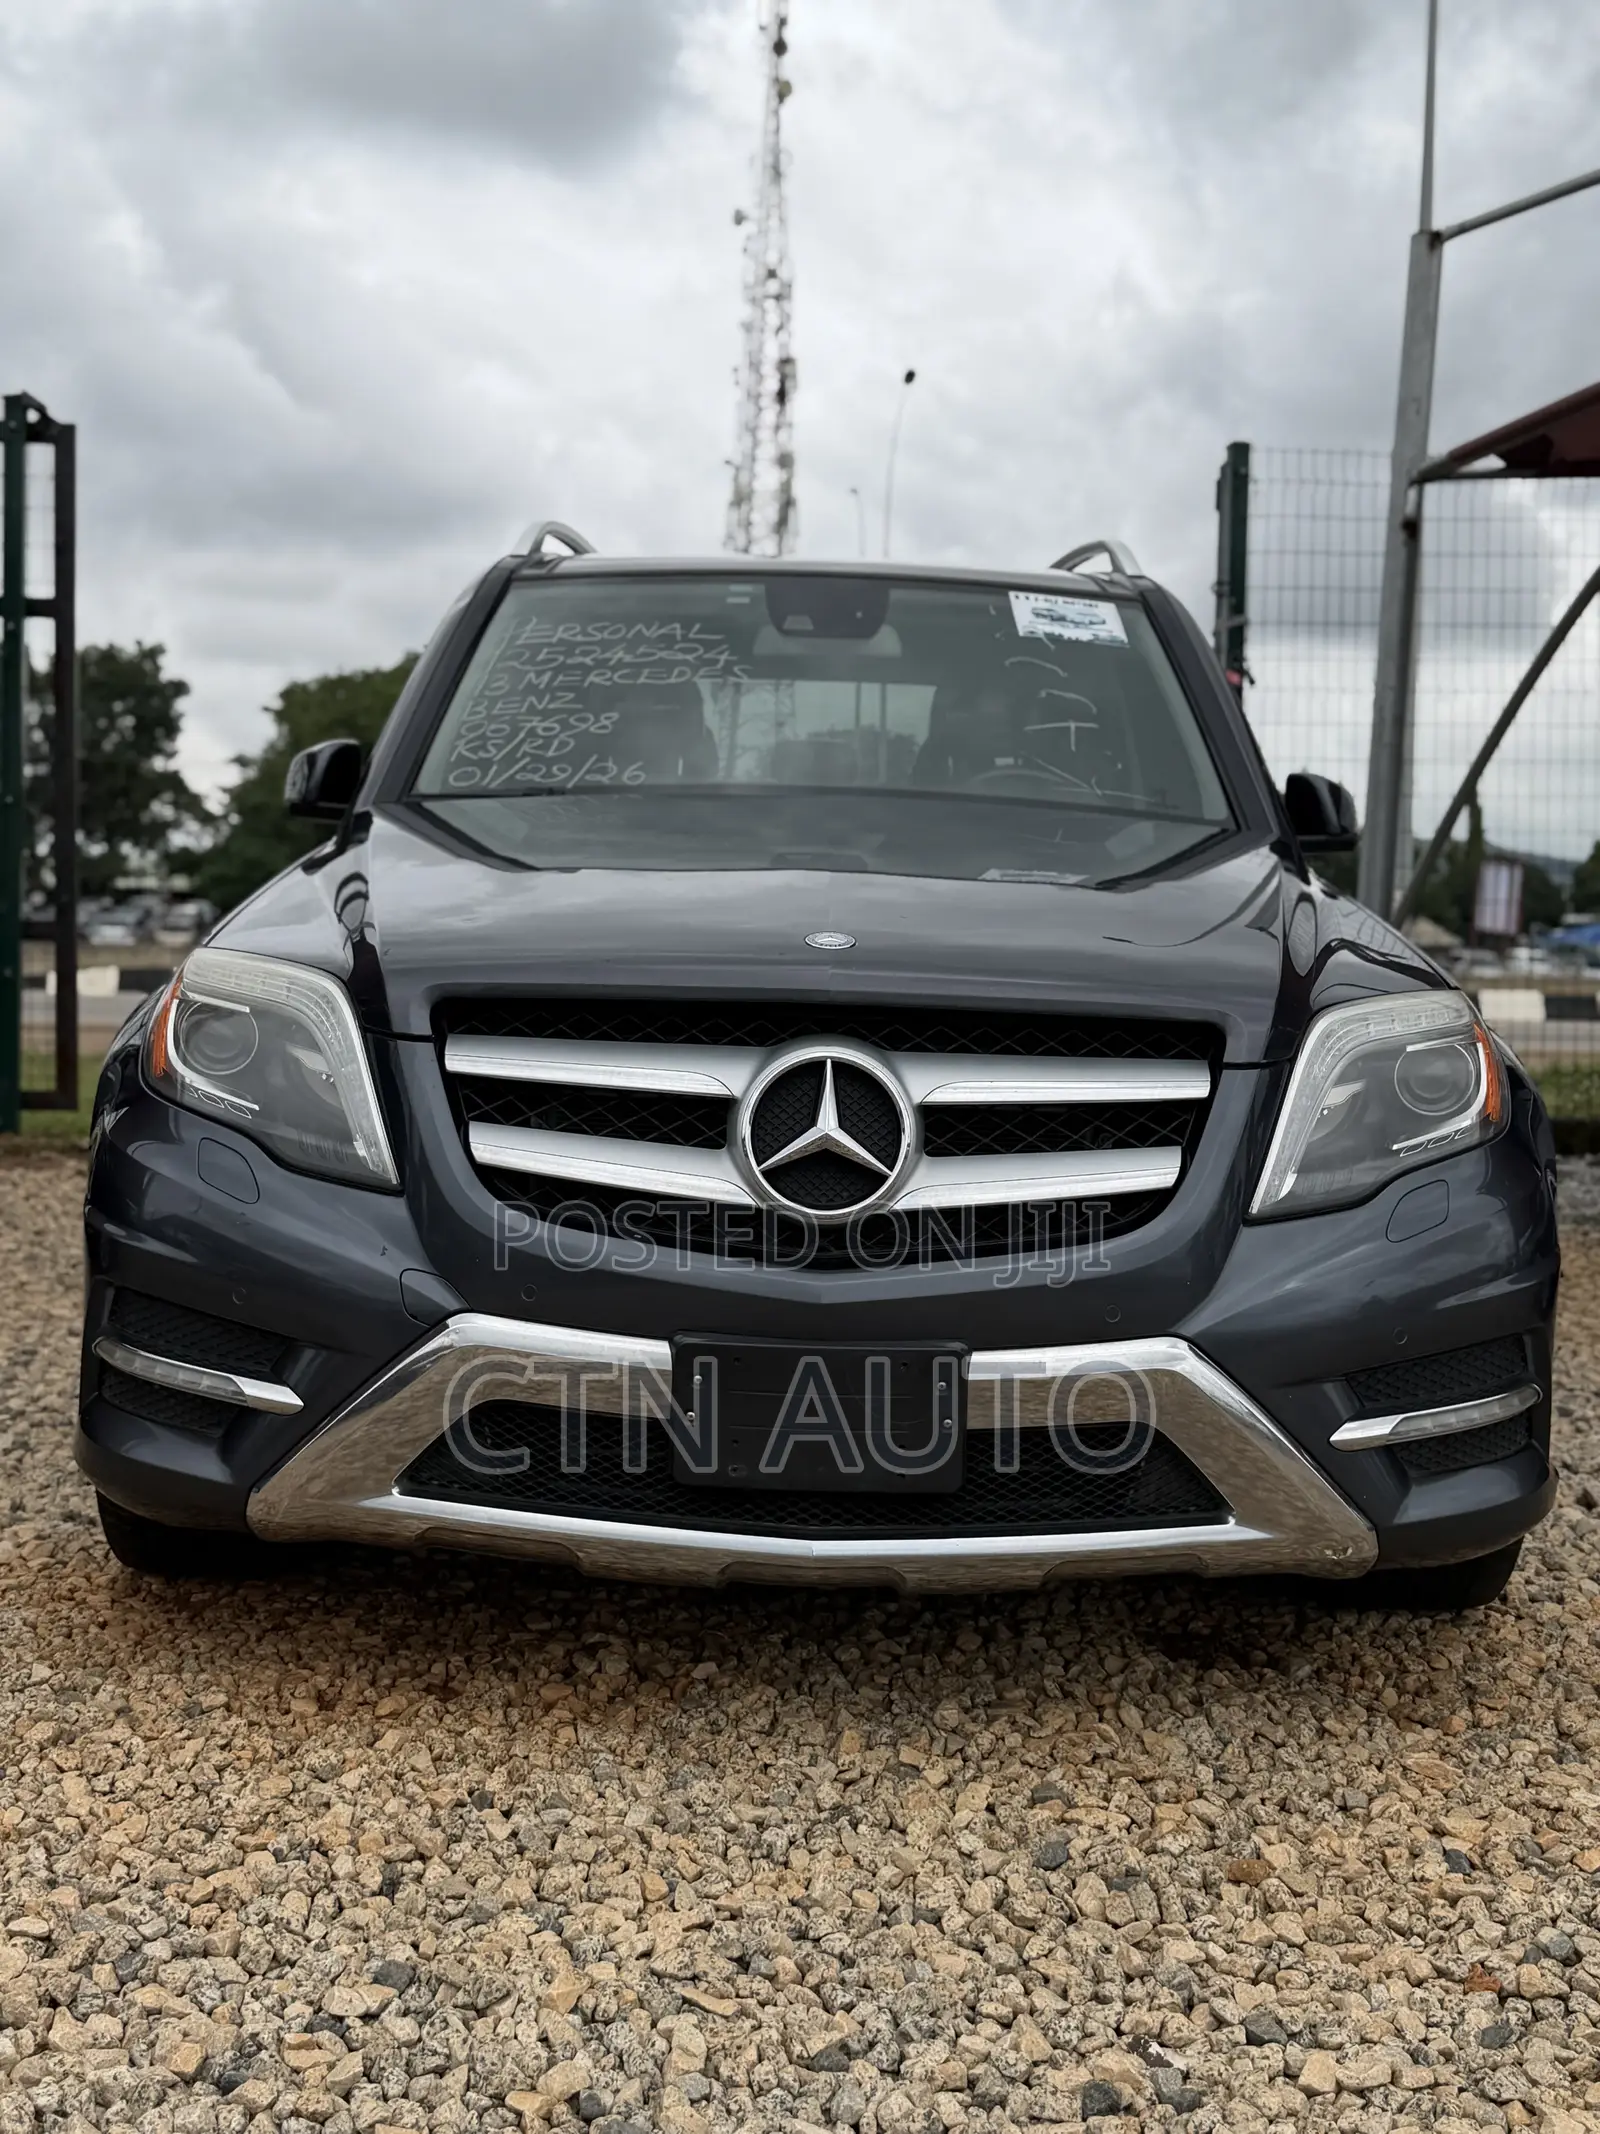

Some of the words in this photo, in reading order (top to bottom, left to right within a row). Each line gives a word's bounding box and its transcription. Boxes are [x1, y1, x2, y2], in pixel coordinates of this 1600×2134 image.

[519, 665, 753, 691] MERCEDES
[463, 693, 583, 721] BENZ
[448, 754, 646, 789] 01/29/26
